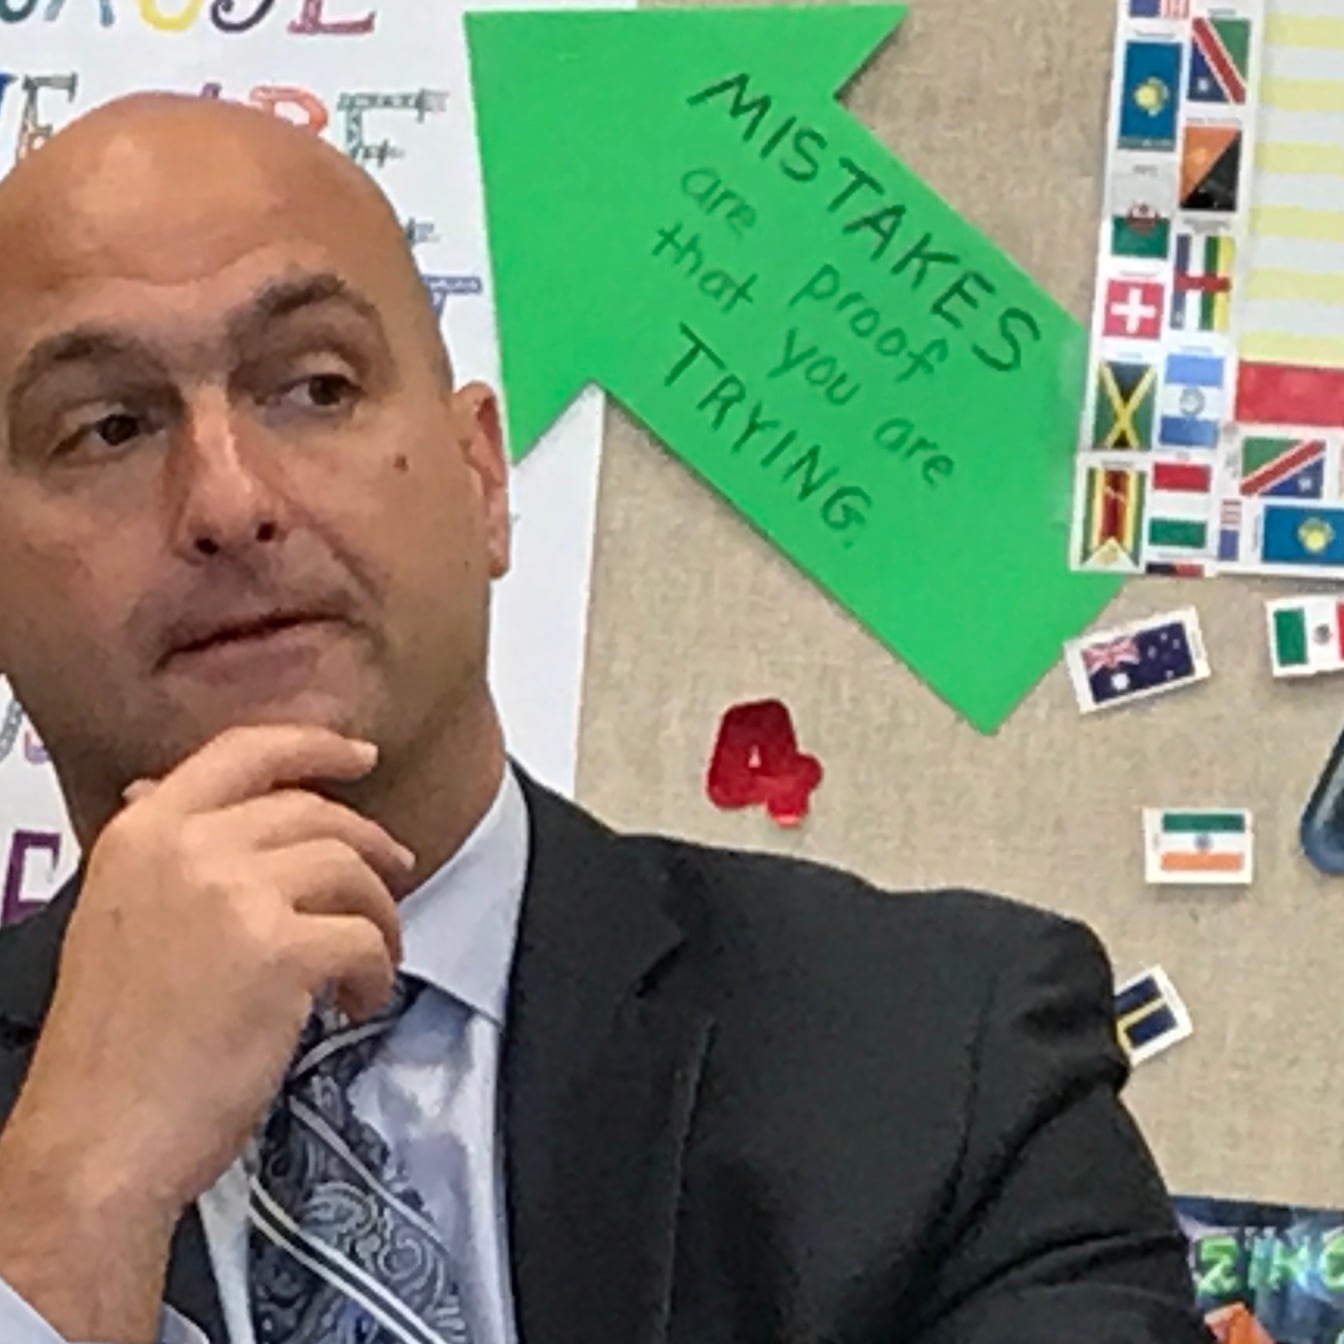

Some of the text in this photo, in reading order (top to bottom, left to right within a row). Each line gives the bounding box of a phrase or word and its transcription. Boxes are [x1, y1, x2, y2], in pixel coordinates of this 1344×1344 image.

[652, 221, 955, 493] that you are
[679, 166, 949, 383] are proof
[686, 72, 1042, 373] MISTAKES
